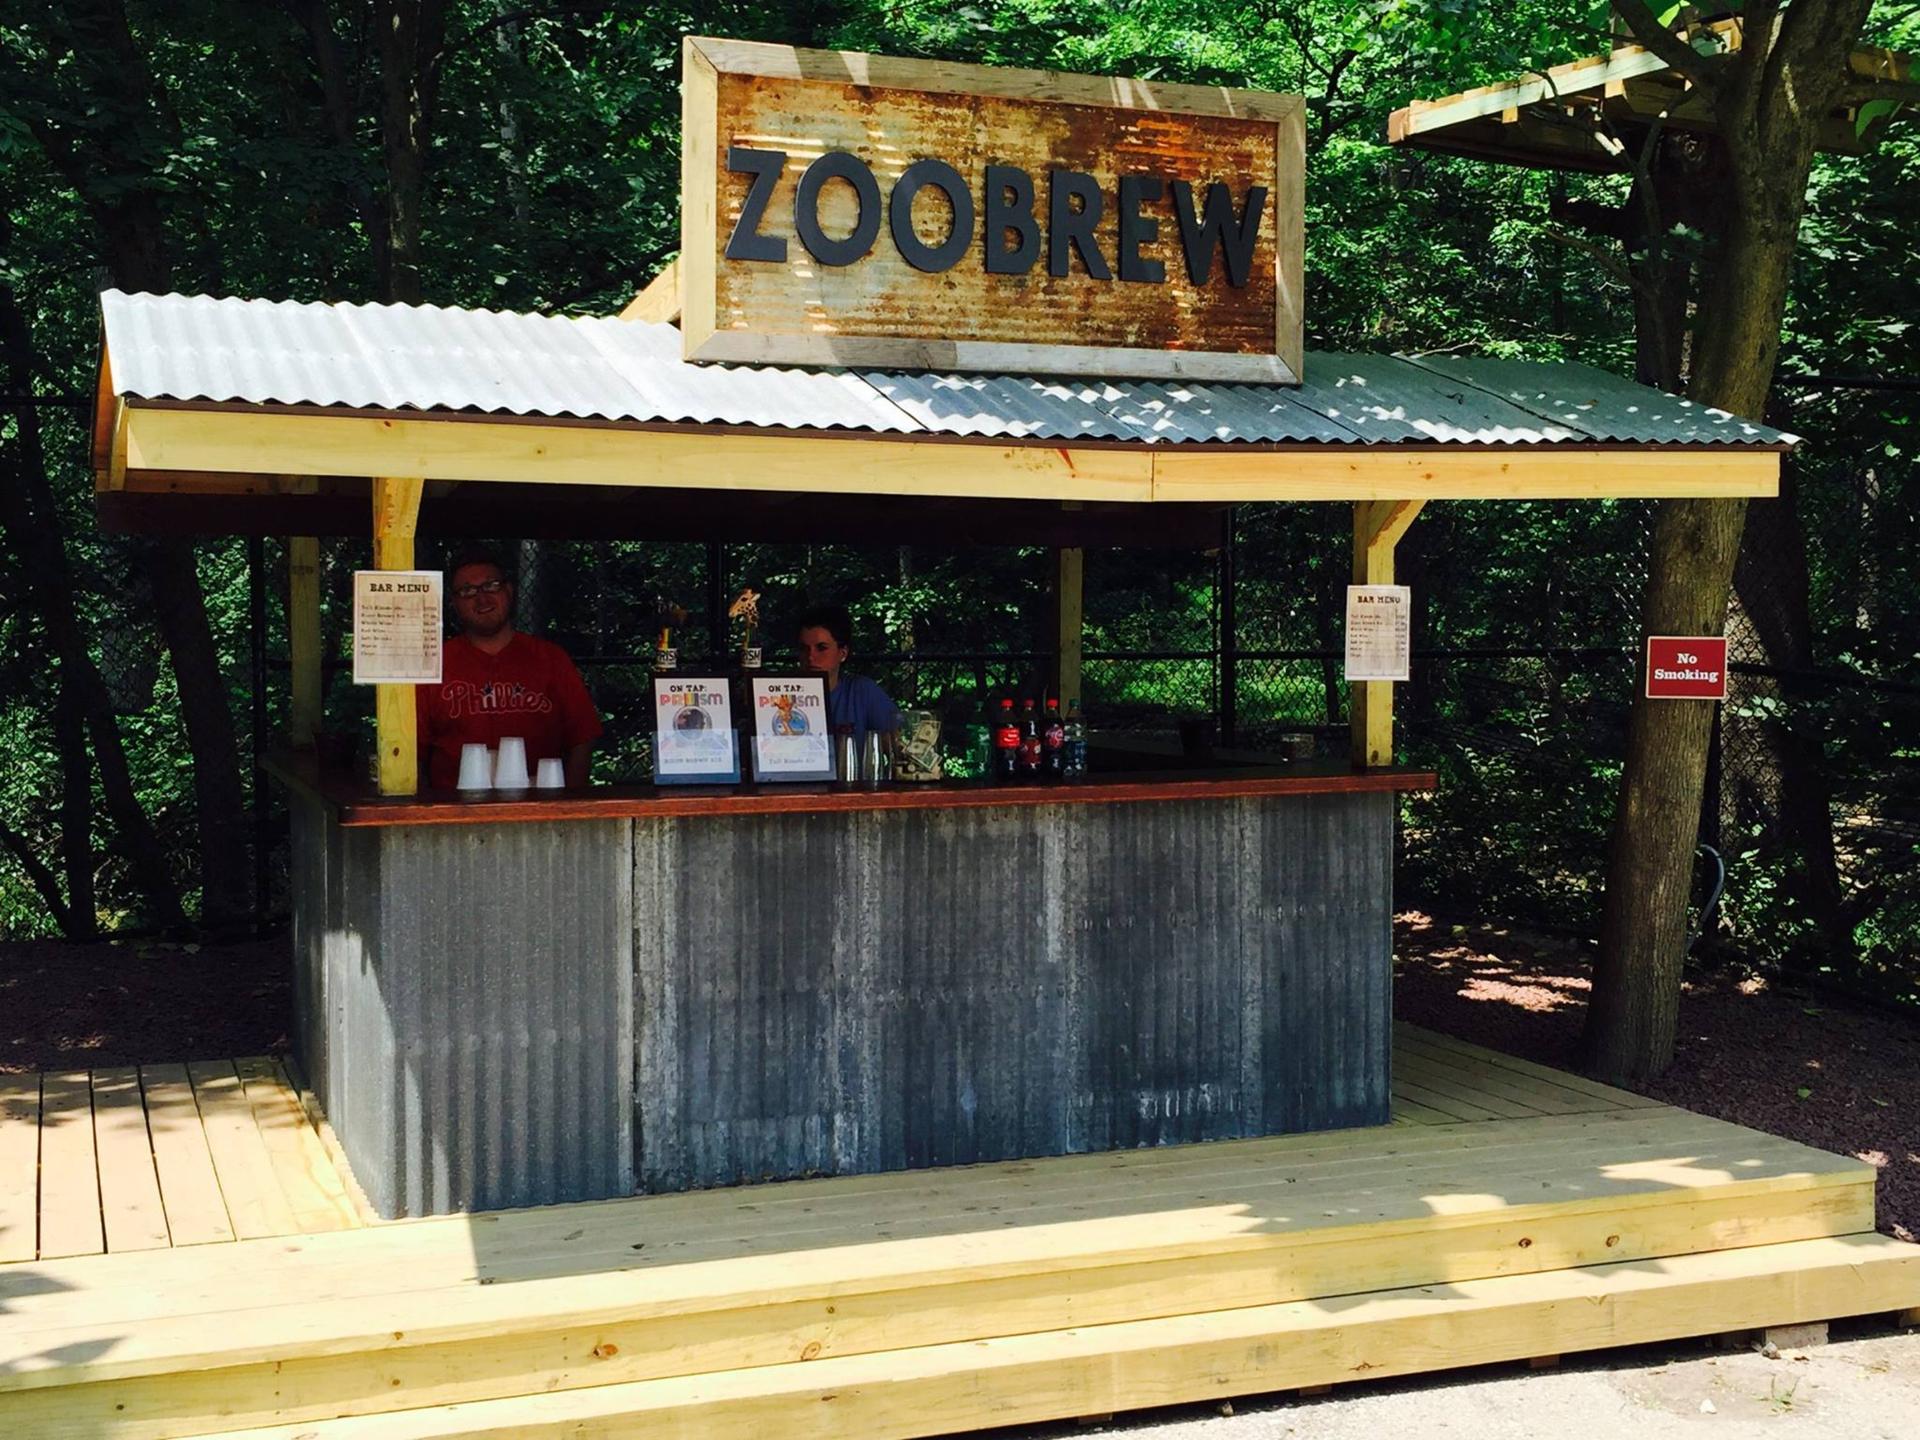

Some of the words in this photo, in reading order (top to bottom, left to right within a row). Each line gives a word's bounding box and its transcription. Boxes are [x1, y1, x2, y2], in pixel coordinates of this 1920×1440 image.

[725, 146, 1268, 288] ZOOBREW
[369, 583, 393, 593] BAR
[397, 583, 430, 593] MENU
[1357, 595, 1375, 604] BAR
[1377, 596, 1401, 604] MENU
[1676, 653, 1698, 664] No
[1654, 668, 1719, 683] Smoking
[441, 680, 552, 719] Phillies
